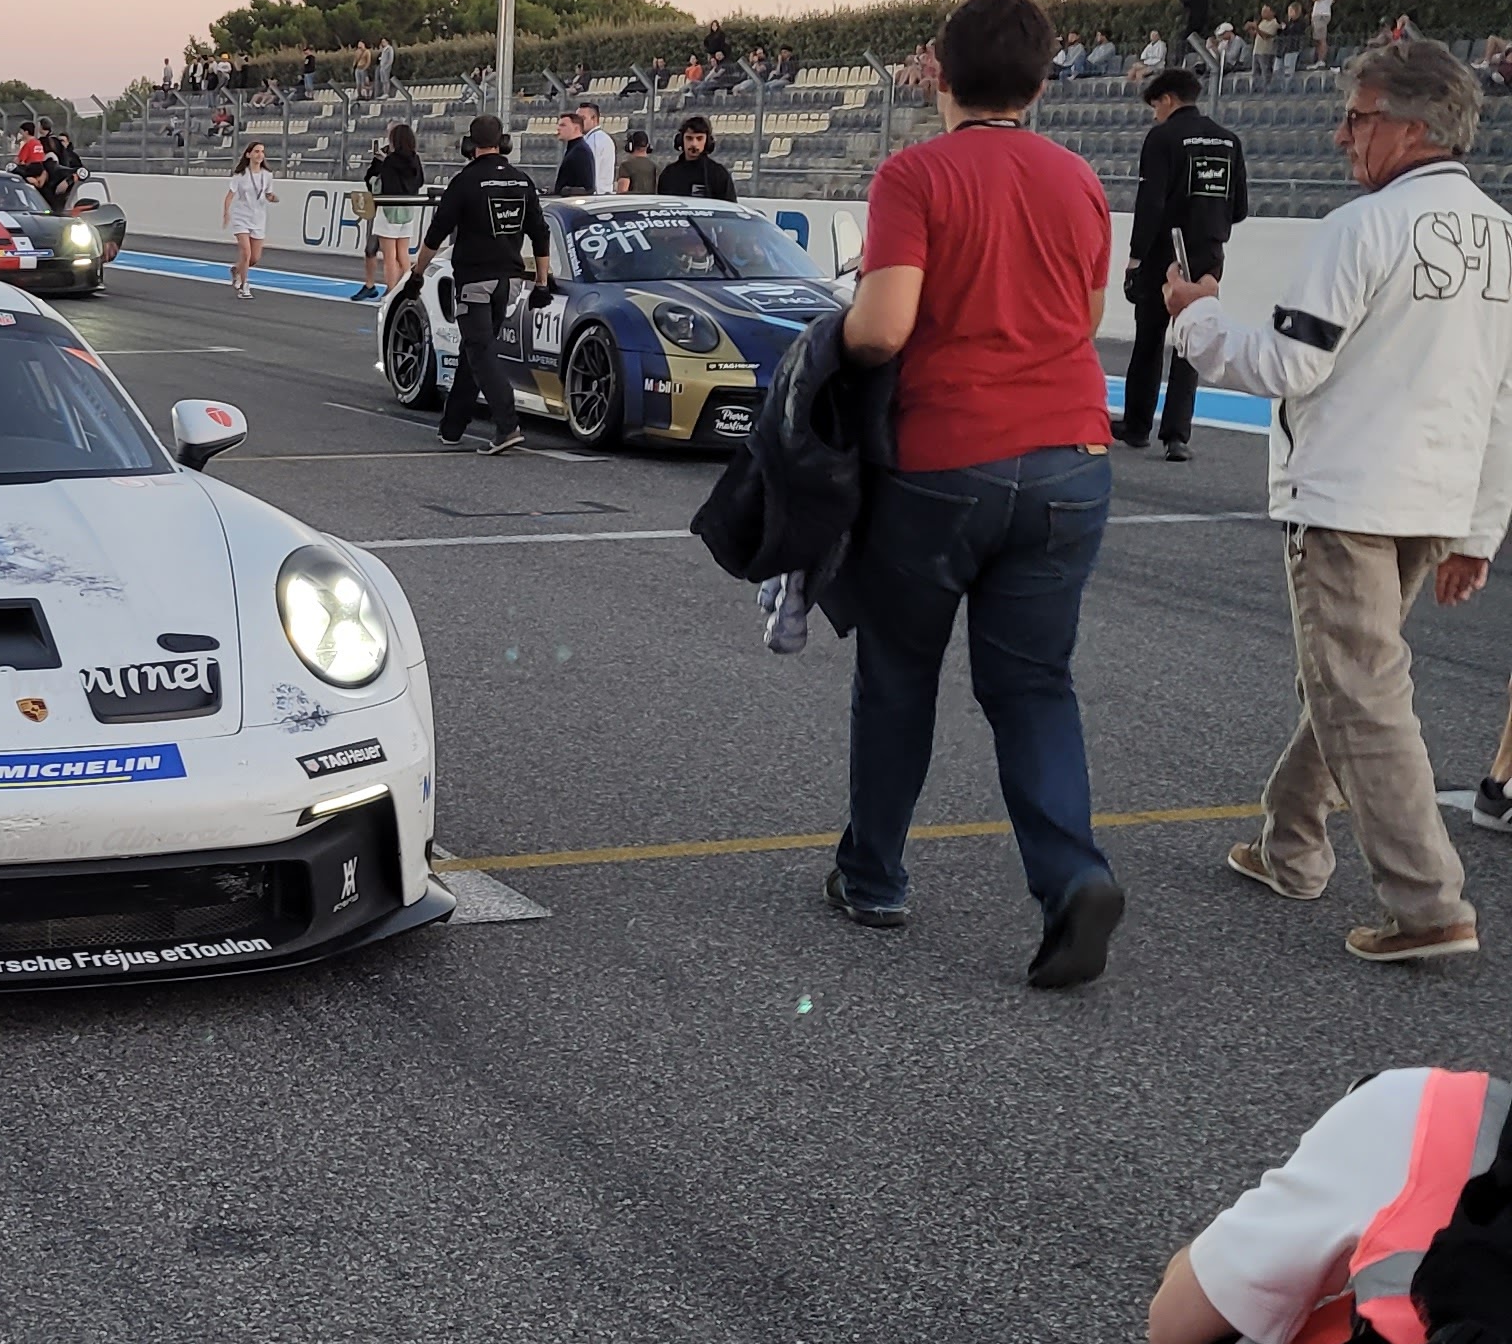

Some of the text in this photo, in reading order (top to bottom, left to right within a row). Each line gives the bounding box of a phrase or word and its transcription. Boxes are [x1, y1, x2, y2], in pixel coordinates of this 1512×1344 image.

[612, 218, 690, 231] Lapierre
[580, 230, 652, 260] 911
[535, 311, 562, 345] 911
[527, 354, 558, 367] LAPIERRE
[73, 947, 159, 972] Fréjus
